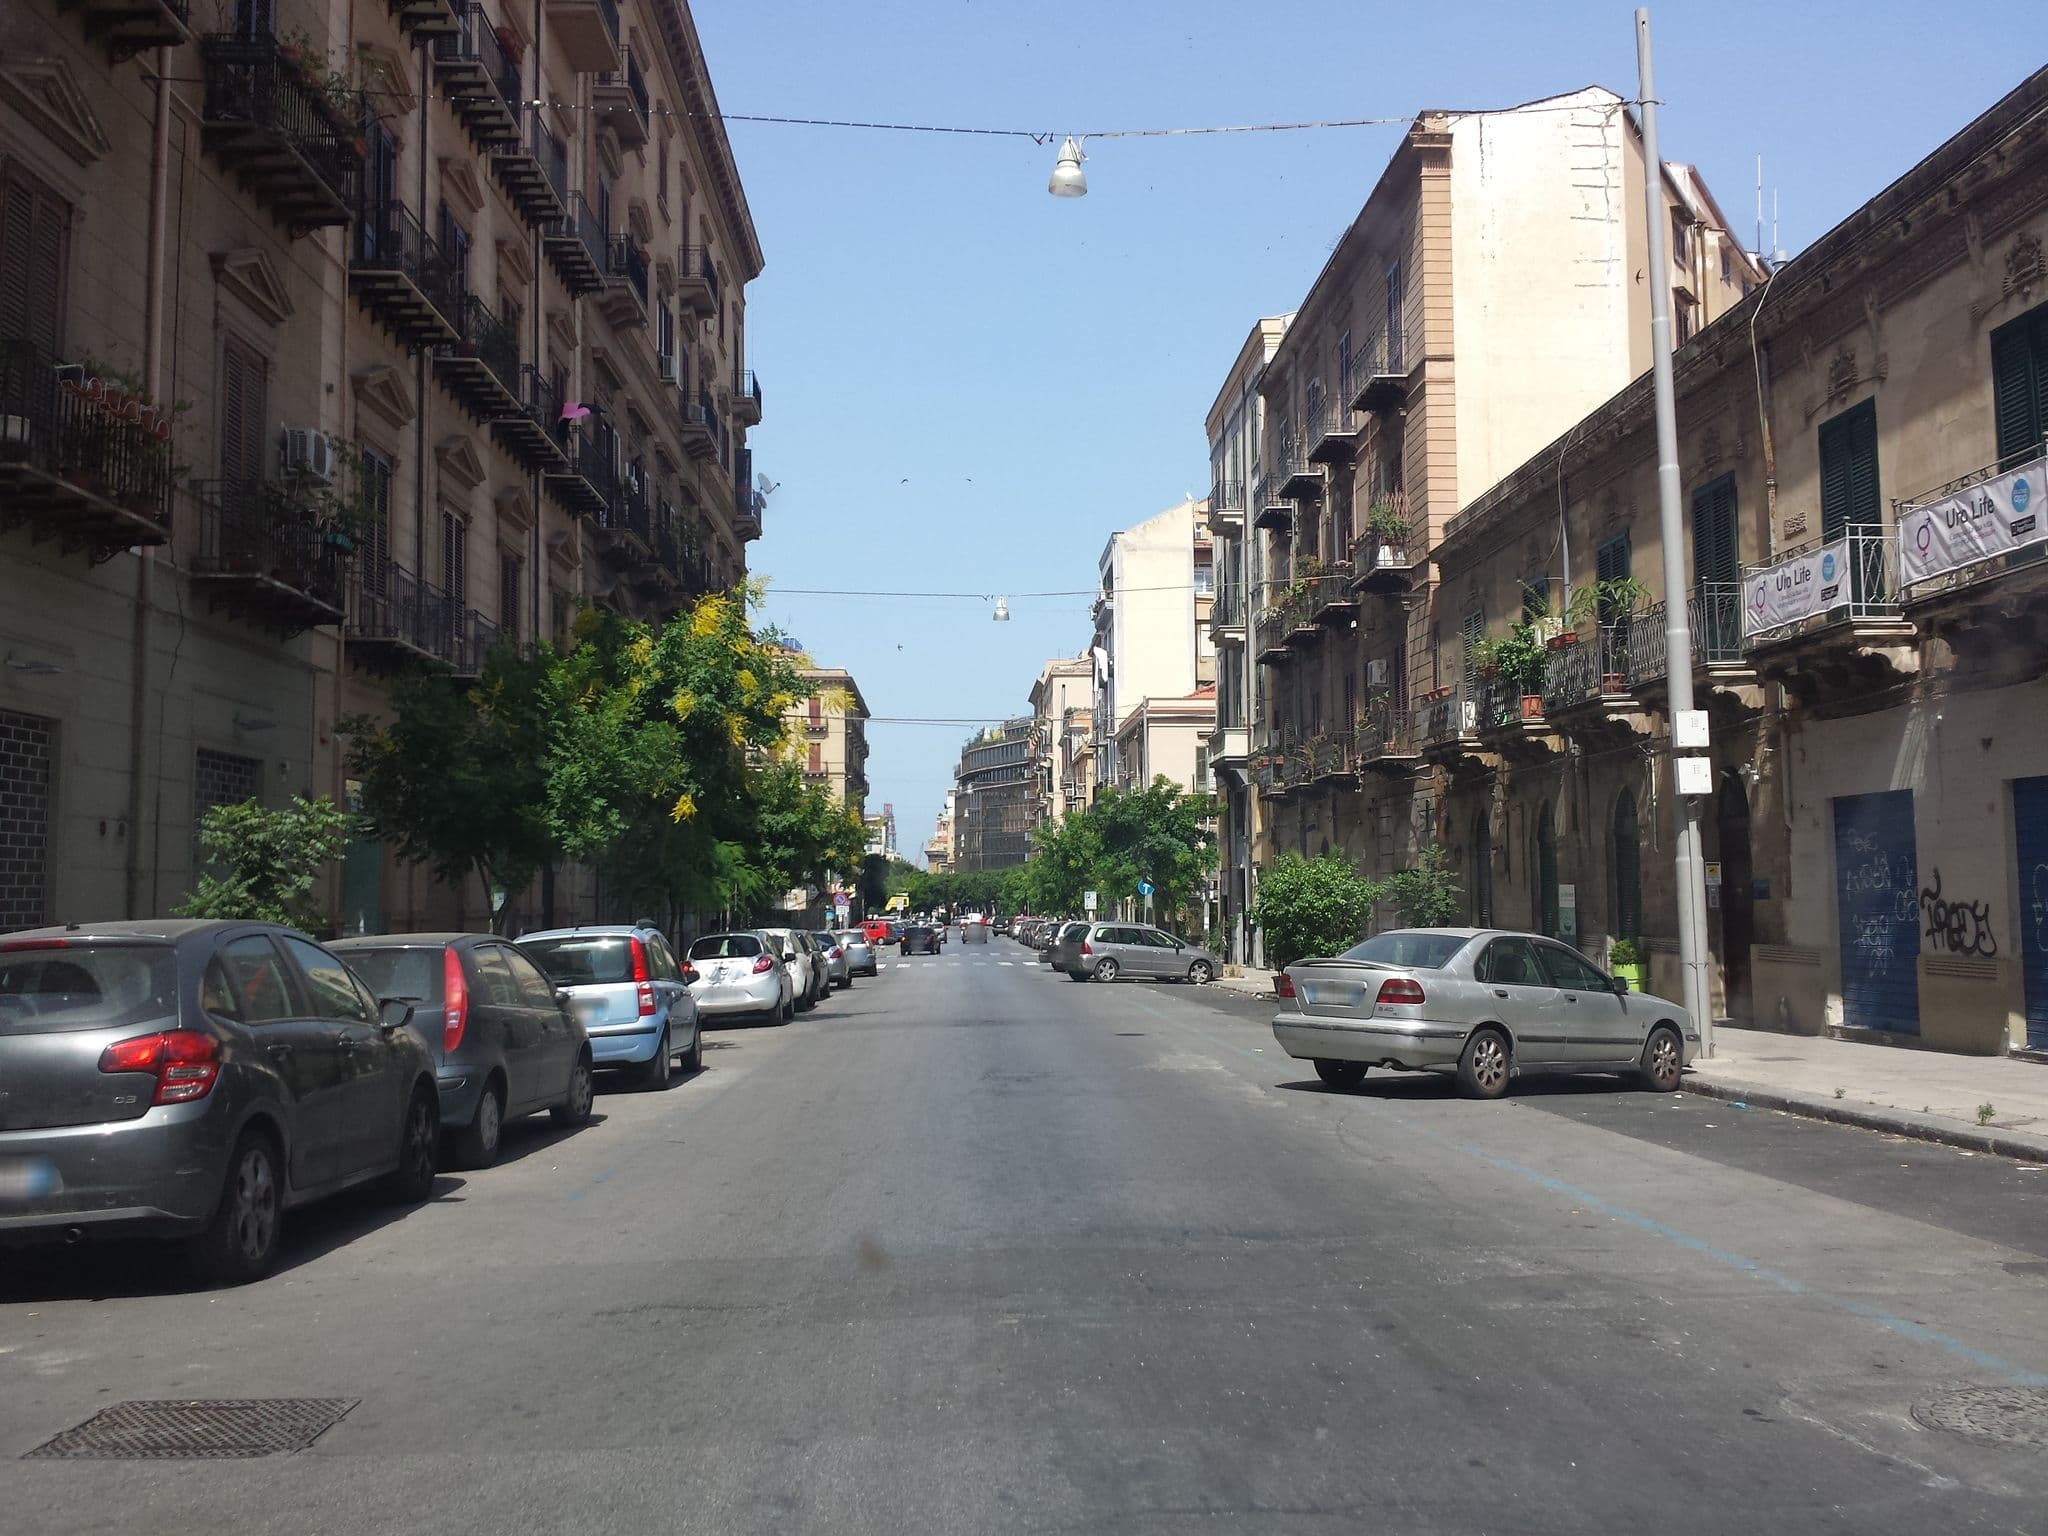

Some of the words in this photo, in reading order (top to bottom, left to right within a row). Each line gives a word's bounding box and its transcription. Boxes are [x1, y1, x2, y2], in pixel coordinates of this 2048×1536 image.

[1946, 507, 1968, 528] Uro
[1972, 494, 1995, 520] Life
[1776, 574, 1791, 592] Uro
[1794, 566, 1811, 586] Life
[113, 1095, 137, 1104] C3
